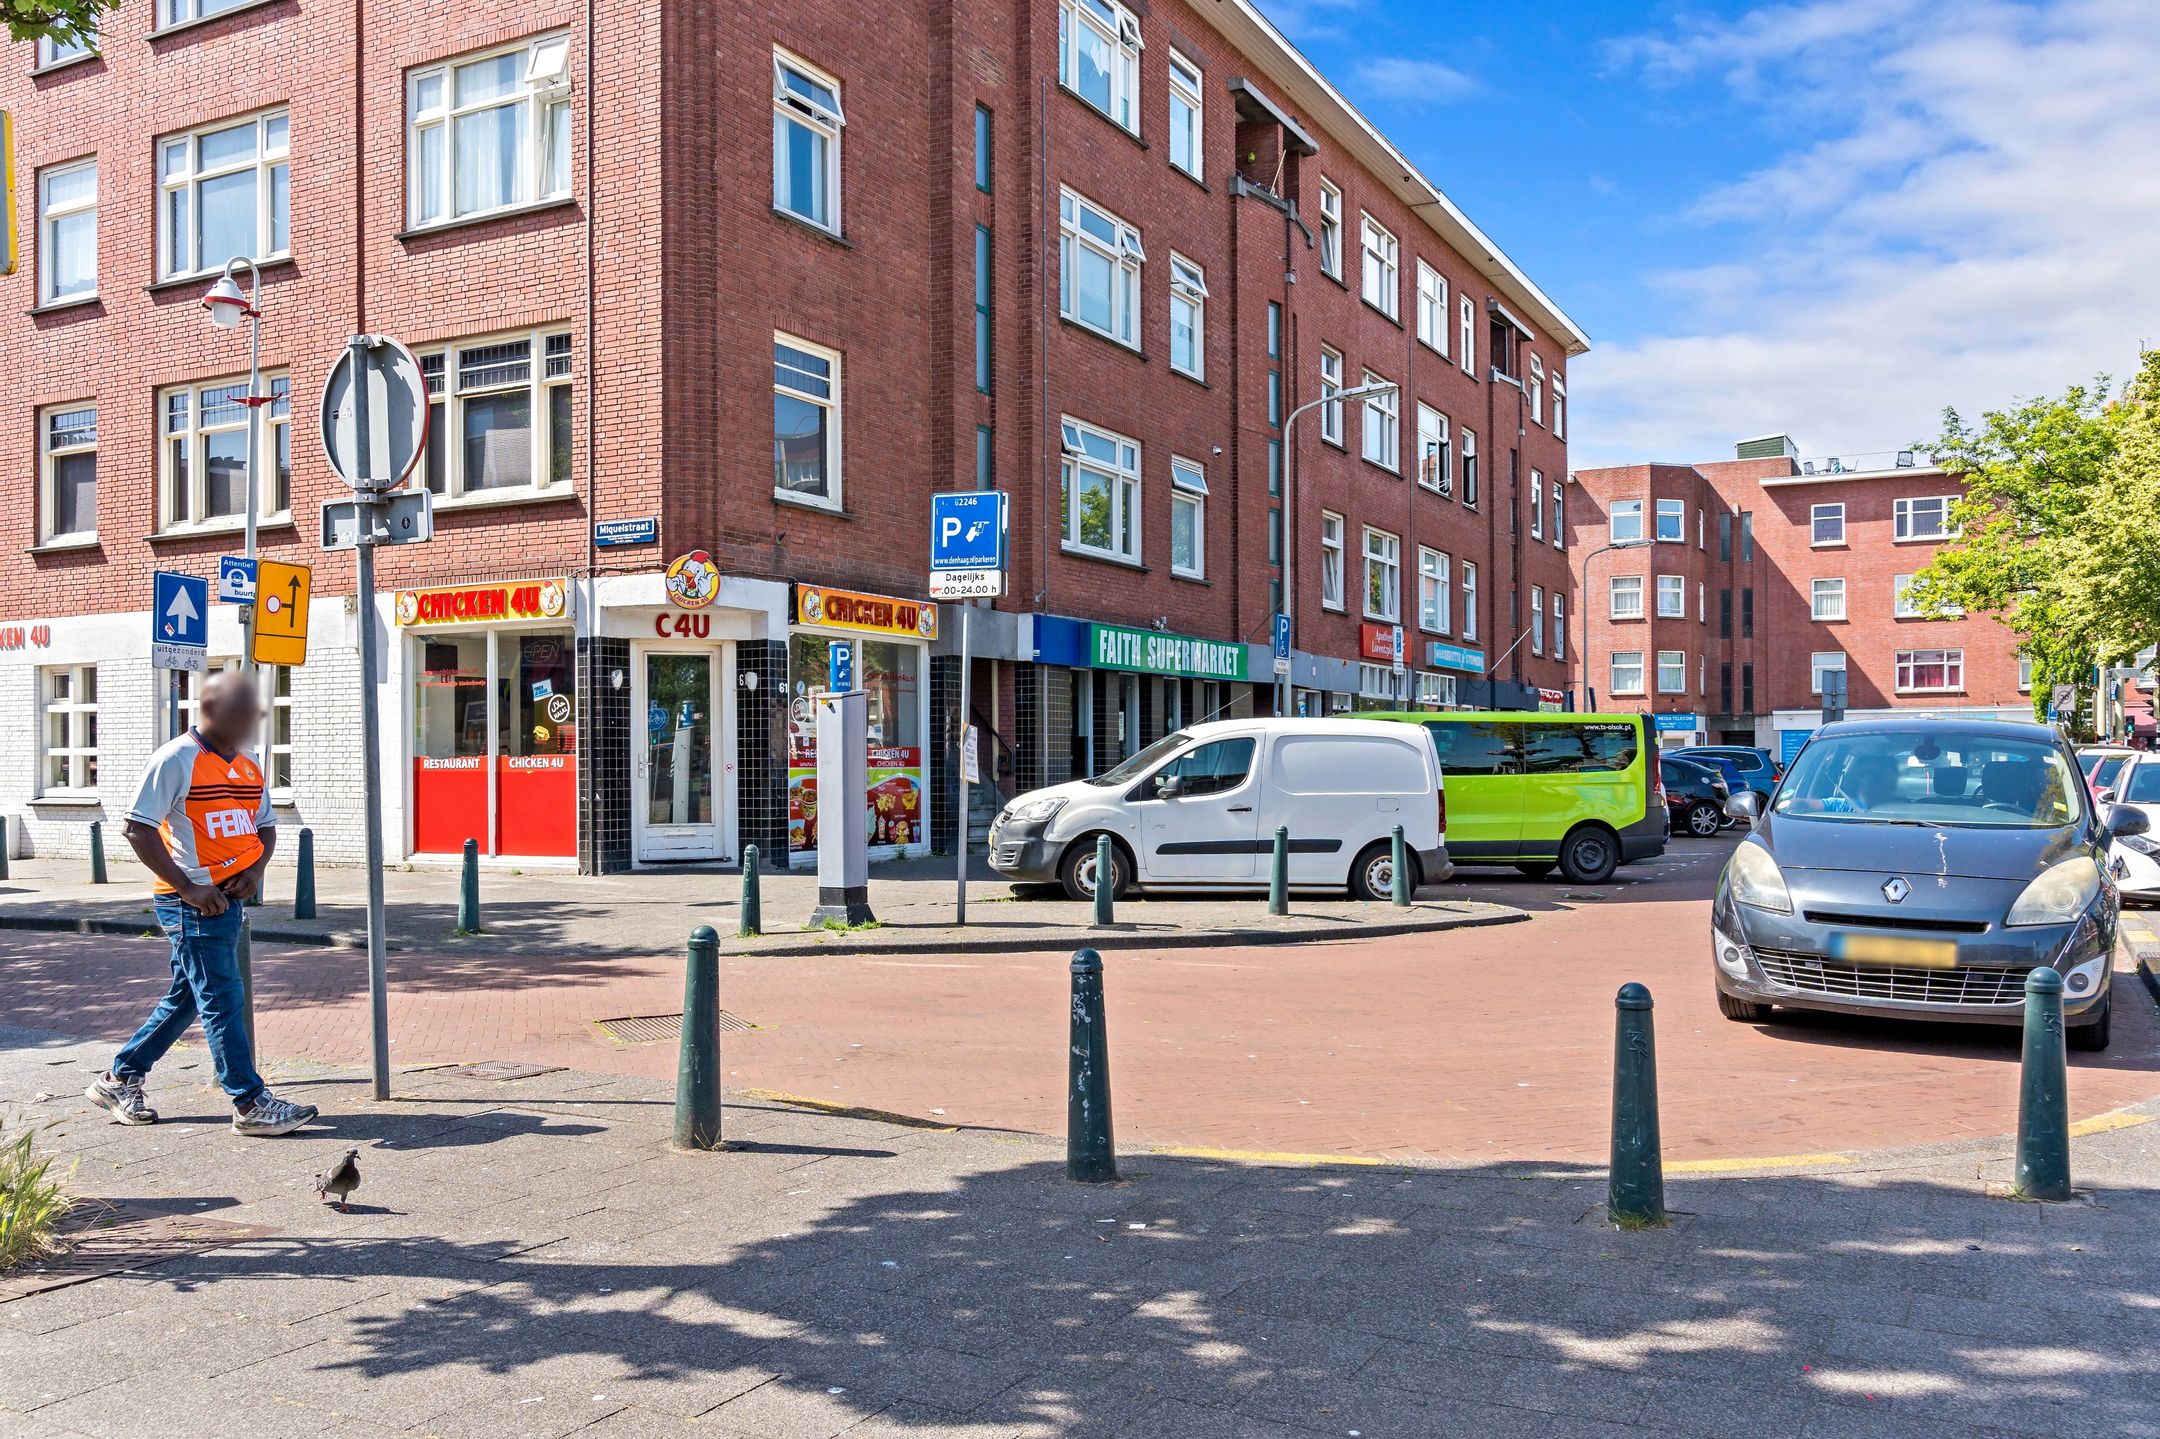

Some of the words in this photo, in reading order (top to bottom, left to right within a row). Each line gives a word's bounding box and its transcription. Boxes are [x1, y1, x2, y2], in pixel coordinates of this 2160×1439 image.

[600, 521, 650, 535] Miquelstraat
[942, 518, 962, 547] P
[223, 559, 254, 569] Attentie!
[946, 573, 986, 584] Dagelijks
[418, 588, 507, 620] CHICKEN
[510, 586, 541, 614] 4U
[673, 593, 700, 606] CHICKEN
[700, 596, 710, 606] 4U
[825, 595, 893, 628] CHICKEN
[896, 605, 917, 631] 4U
[1280, 618, 1289, 640] P
[31, 625, 50, 648] 4U
[157, 646, 205, 657] uitgezonderd
[836, 648, 850, 666] P
[1099, 629, 1142, 667] FAITH
[1147, 636, 1239, 676] SUPERMARKET
[553, 706, 568, 720] HALAL
[424, 758, 480, 769] RESTAURANT
[509, 758, 549, 769] CHICKEN
[550, 758, 564, 768] 4U
